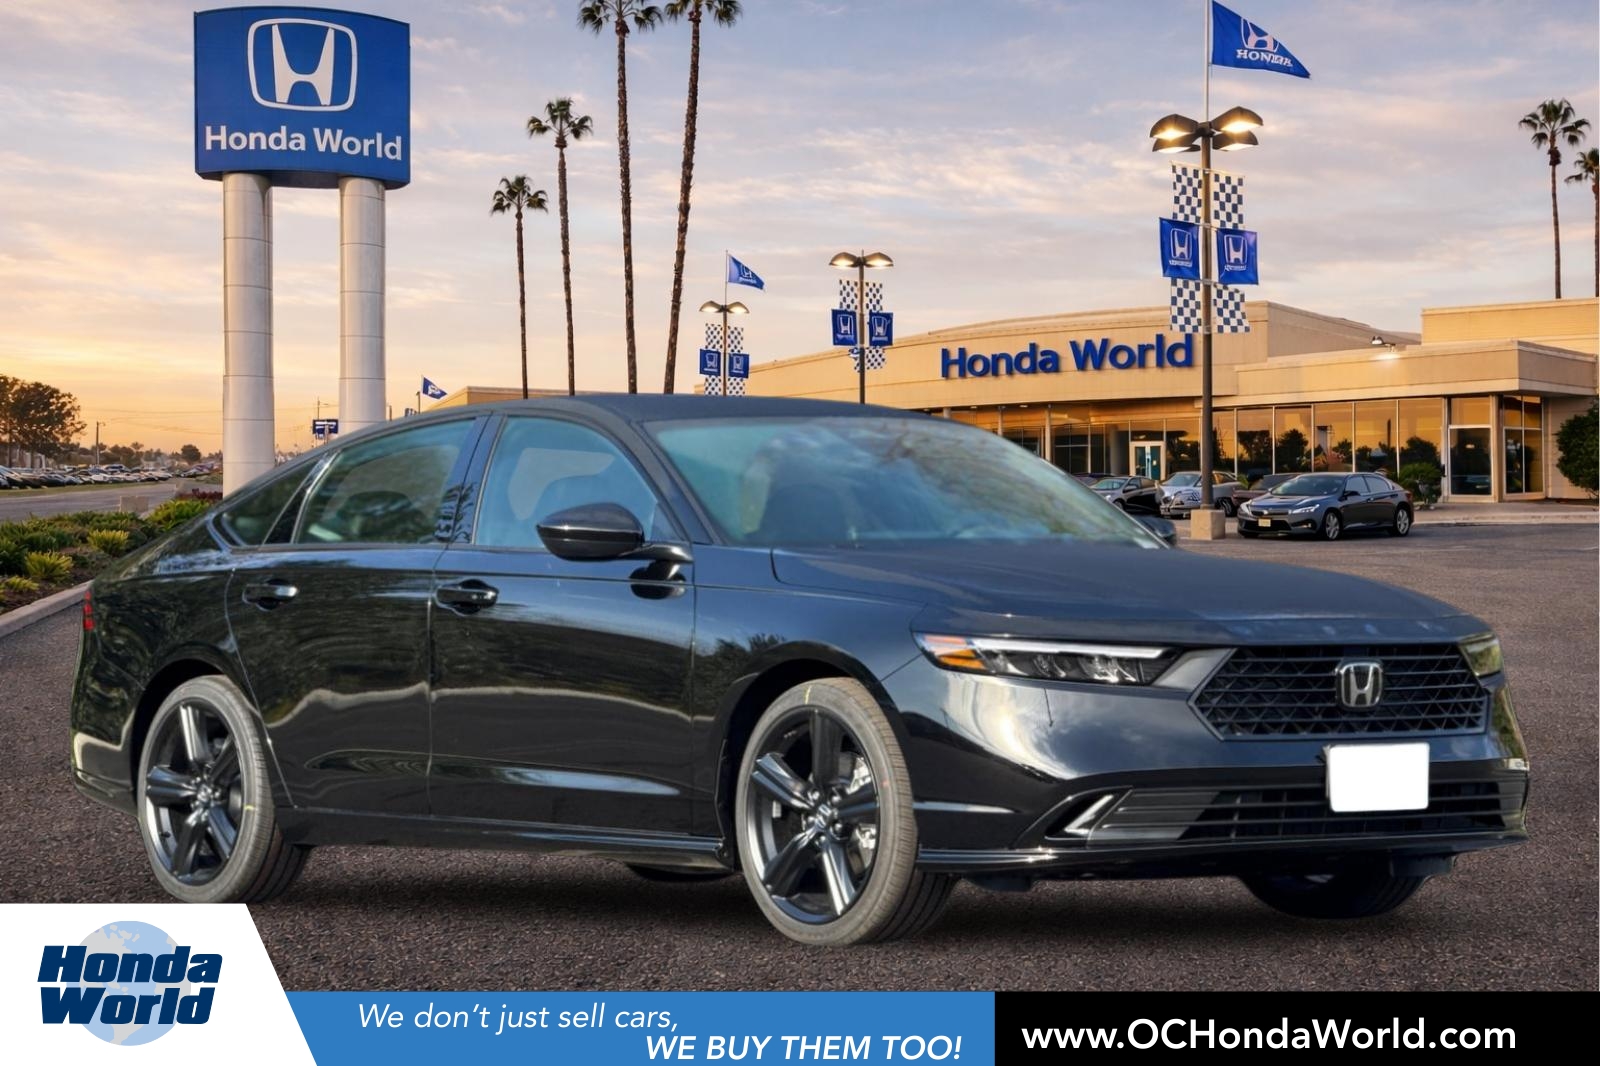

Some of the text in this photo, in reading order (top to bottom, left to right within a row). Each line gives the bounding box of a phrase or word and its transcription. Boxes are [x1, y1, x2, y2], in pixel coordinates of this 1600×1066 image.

[205, 125, 402, 161] Honda World
[941, 334, 1194, 378] Honda World
